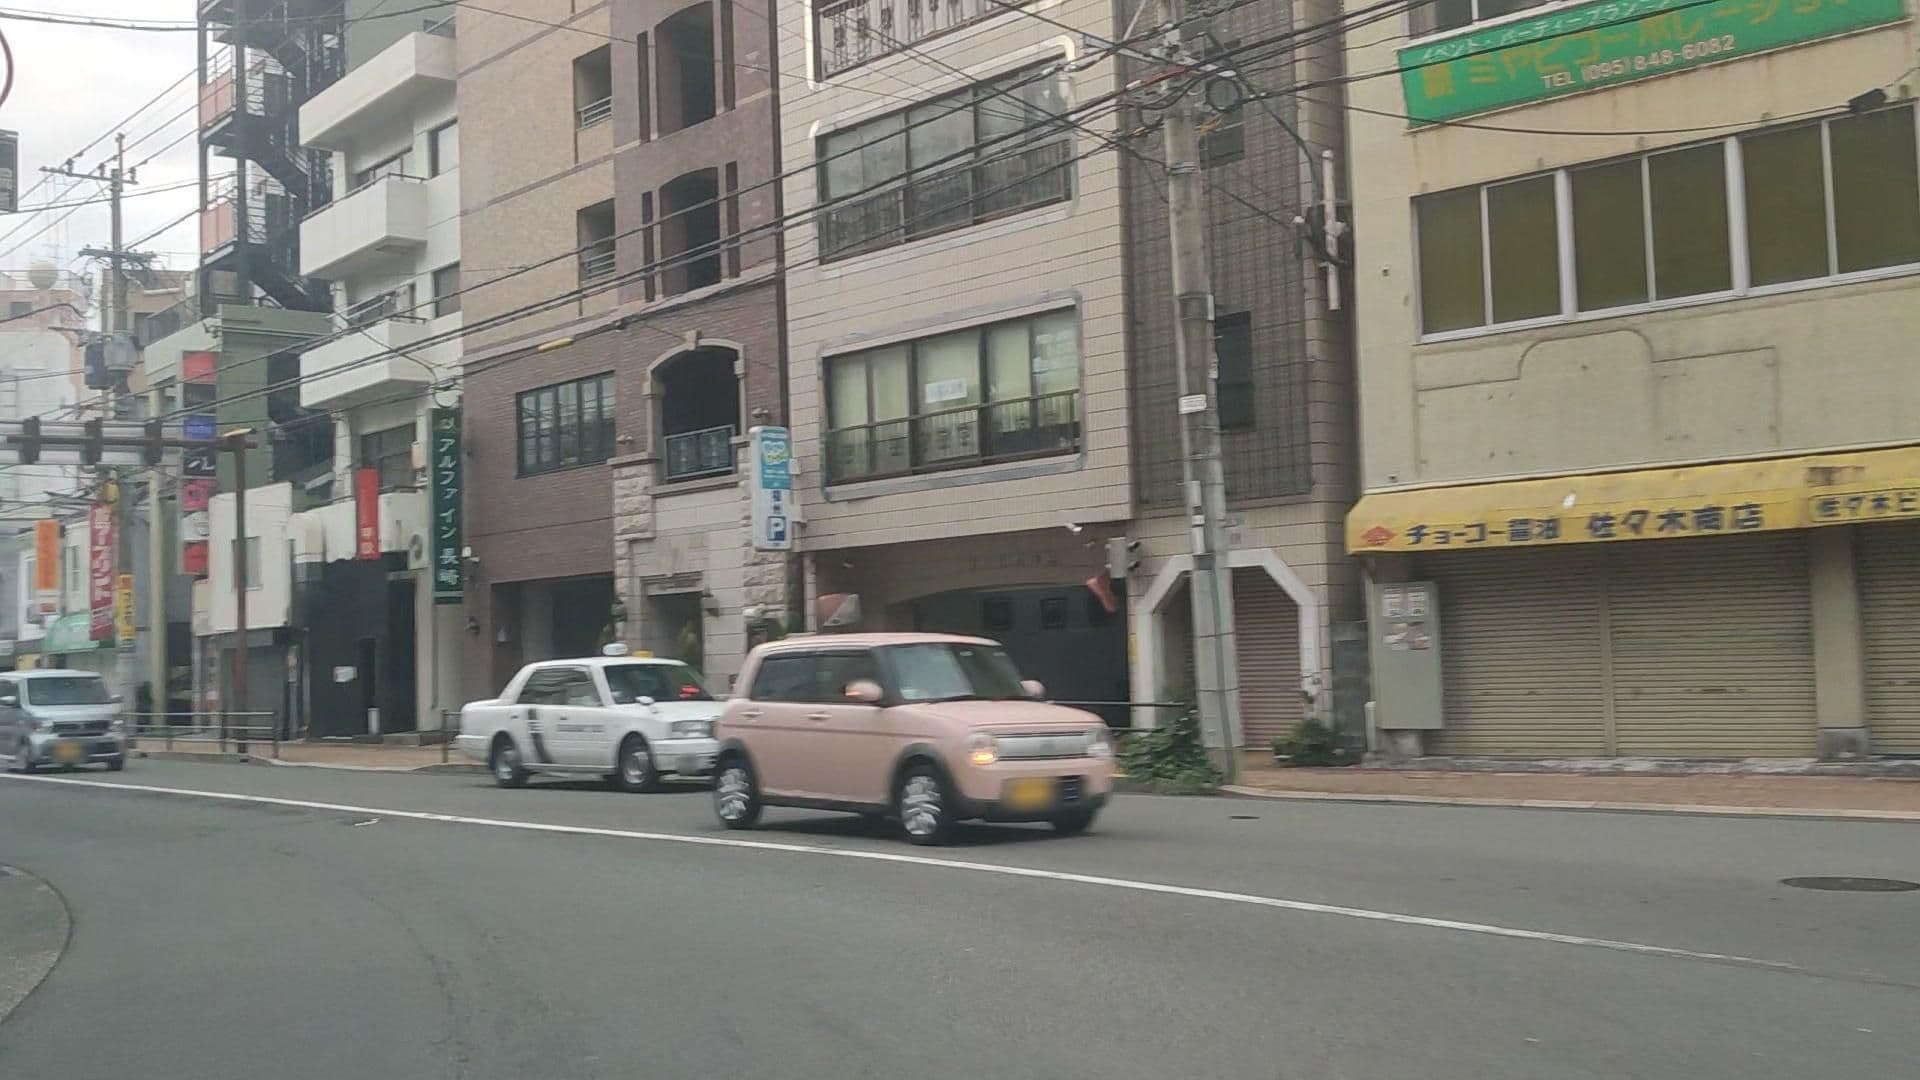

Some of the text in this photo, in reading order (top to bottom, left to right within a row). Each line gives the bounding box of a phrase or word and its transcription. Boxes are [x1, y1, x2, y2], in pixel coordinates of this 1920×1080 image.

[1541, 71, 1577, 88] TEL
[1634, 34, 1736, 71] 848-6082
[1586, 502, 1765, 538] 佐々木商店
